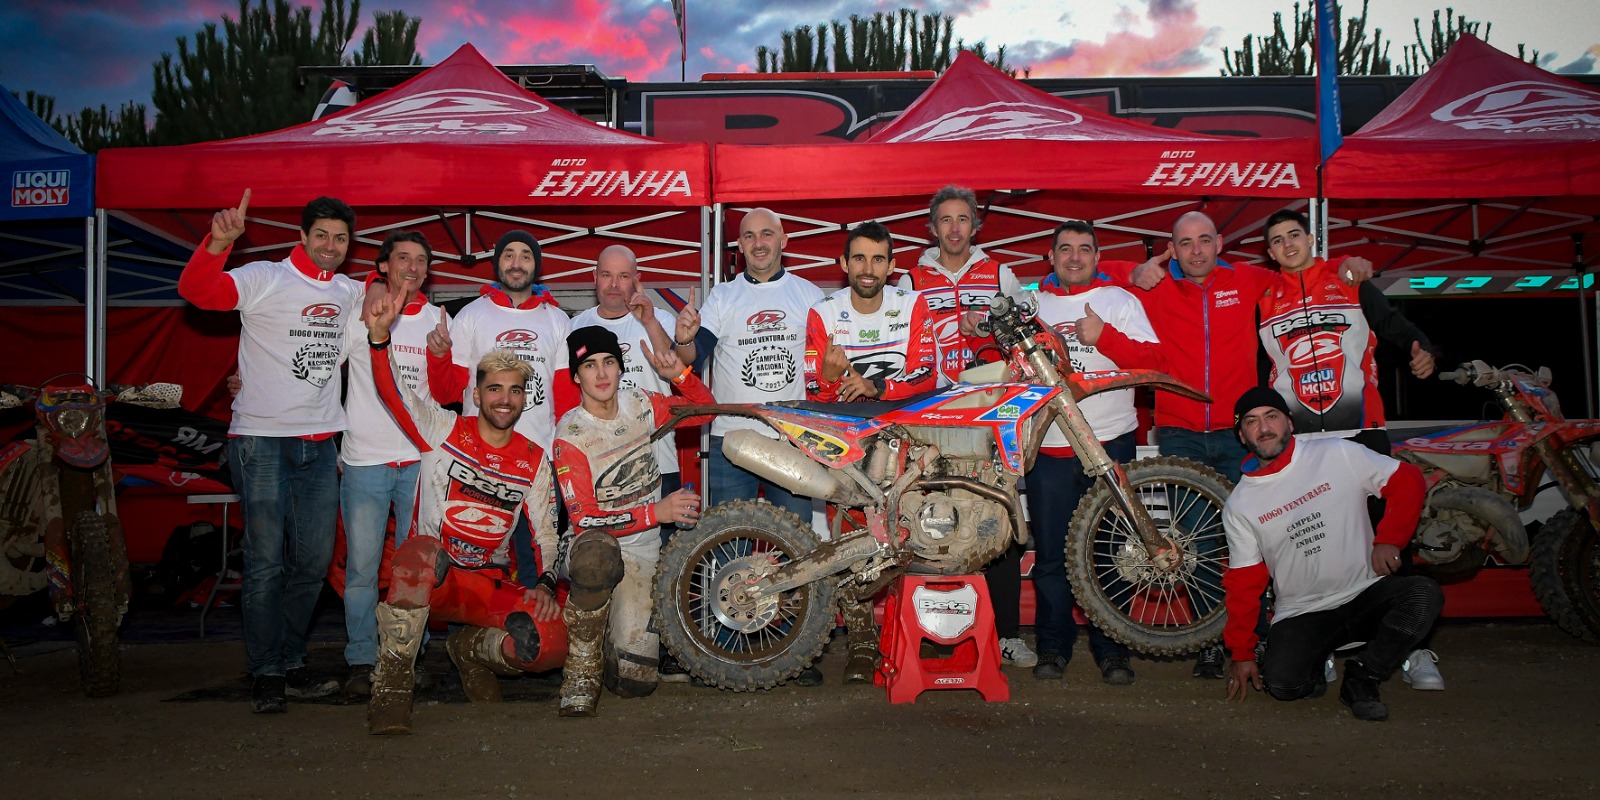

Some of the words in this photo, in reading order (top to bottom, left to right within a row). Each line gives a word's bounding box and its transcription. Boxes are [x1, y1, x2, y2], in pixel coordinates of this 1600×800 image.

[312, 120, 527, 135] Beta
[1453, 114, 1600, 130] Bet
[1161, 151, 1195, 159] MOTO
[551, 159, 587, 167] MOTO
[16, 172, 67, 188] LIQUI
[1142, 163, 1300, 188] ESPINHA
[528, 171, 692, 197] ESPINHA
[15, 188, 67, 205] MOLY
[1272, 311, 1346, 338] Beta
[289, 329, 312, 338] DIOGO
[313, 331, 337, 339] VENTURA
[738, 337, 757, 346] DIOGO
[758, 334, 785, 343] VENTURA
[786, 333, 797, 341] #52
[496, 341, 537, 349] Beta
[756, 353, 785, 363] CAMPEÃO
[631, 365, 644, 373] #52
[756, 362, 785, 372] NACIONAL
[1300, 369, 1334, 384] LIQUI
[765, 381, 781, 389] 2022
[1301, 380, 1336, 395] MOLY
[797, 430, 844, 462] 52
[1404, 437, 1491, 450] Beta
[447, 459, 524, 502] Beta
[596, 464, 661, 502] Beta
[462, 486, 503, 508] PORTUGAL
[578, 513, 633, 528] Beta
[1258, 507, 1283, 525] DIOGO
[1286, 511, 1322, 533] CAMPEÃO
[1289, 521, 1326, 542] NACIONAL
[1295, 532, 1326, 549] ENDURO
[1304, 545, 1322, 557] 2022
[919, 599, 970, 610] Beta
